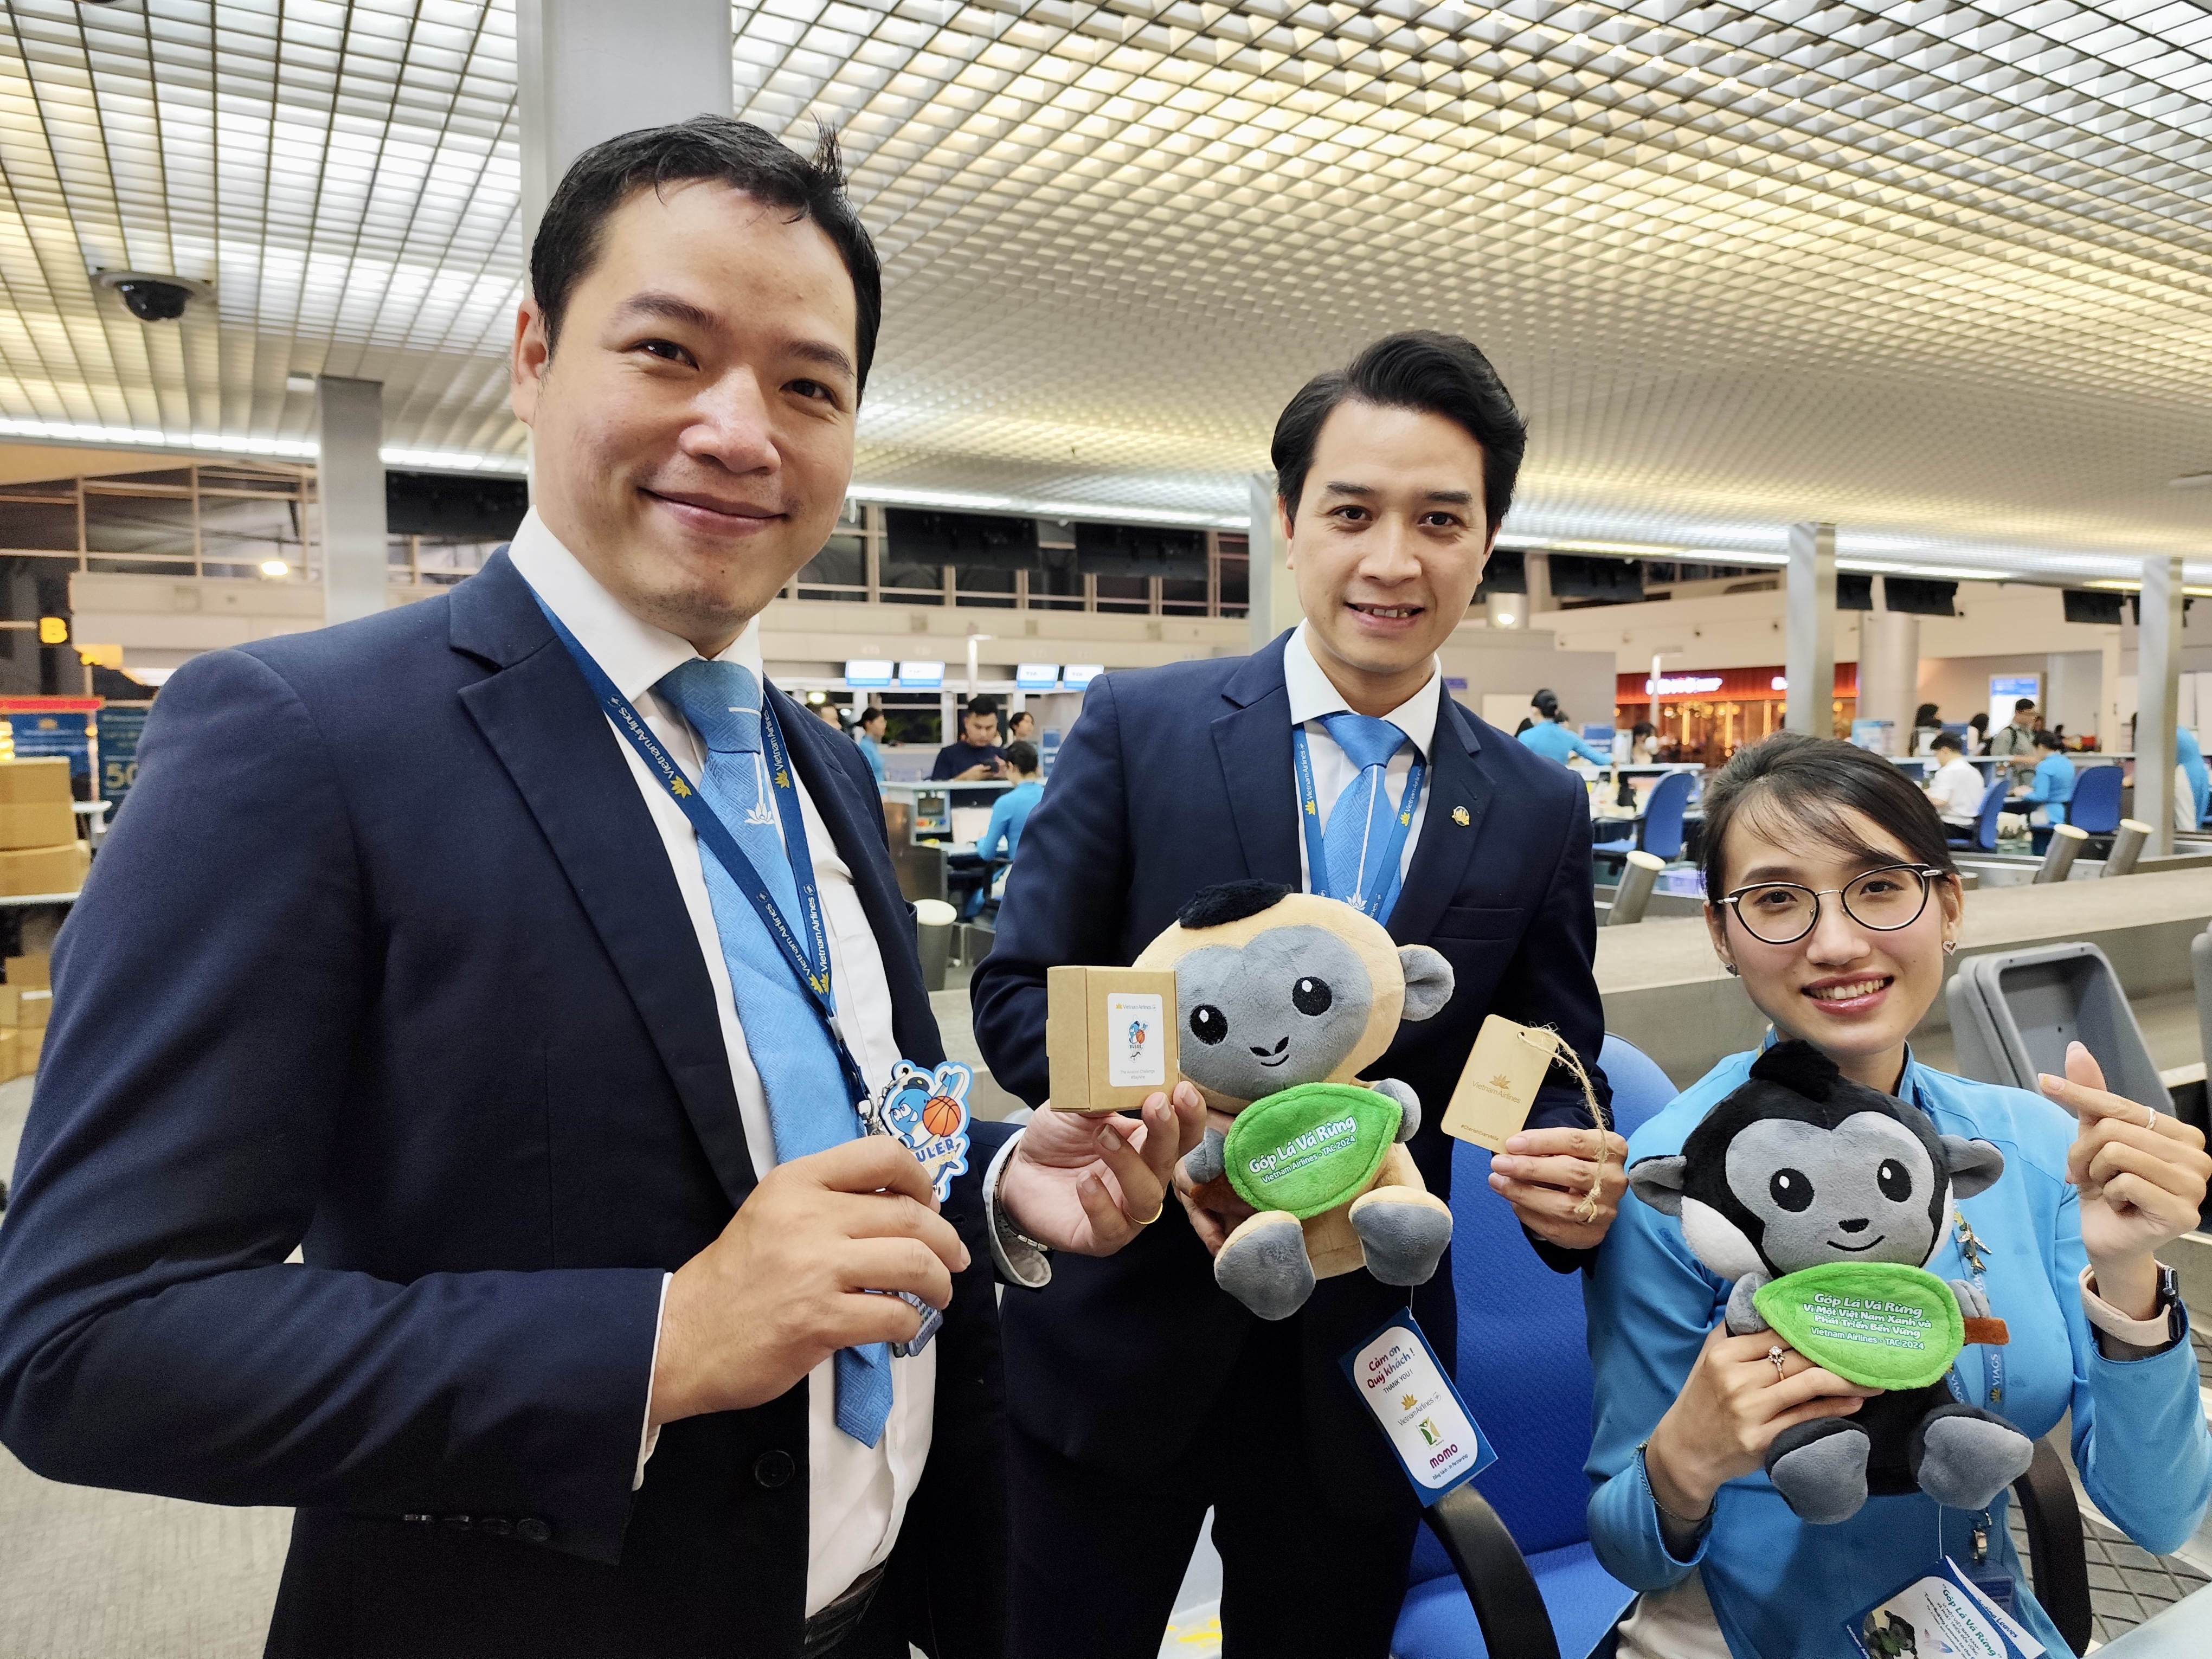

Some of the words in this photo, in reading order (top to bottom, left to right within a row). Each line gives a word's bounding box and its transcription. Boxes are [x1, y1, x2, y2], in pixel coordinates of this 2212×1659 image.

[915, 1138, 955, 1162] ULER
[1249, 1154, 1277, 1173] Góp
[1276, 1141, 1297, 1160] Lá
[1295, 1131, 1317, 1150] Vá
[1315, 1116, 1356, 1142] Rừng
[1261, 1166, 1292, 1183] Vietnam
[1292, 1153, 1318, 1170] Airlines
[1321, 1144, 1336, 1155] TAC
[1335, 1135, 1355, 1149] 2024
[1803, 1303, 1814, 1312] Vì
[1816, 1306, 1837, 1317] Một
[1838, 1309, 1859, 1320] Việt
[1860, 1311, 1885, 1322] Nam
[1887, 1315, 1916, 1327] Xanh
[1917, 1320, 1932, 1328] và
[1814, 1293, 1842, 1308] Góp
[1843, 1297, 1861, 1308] Lá
[1864, 1300, 1882, 1310] Vá
[1884, 1302, 1923, 1319] Rừng
[1811, 1326, 1846, 1339] Vietnam
[1847, 1333, 1877, 1343] Airlines
[1885, 1338, 1900, 1347] TAC
[1901, 1340, 1925, 1350] 2024
[1814, 1315, 1840, 1325] Phát
[1841, 1318, 1869, 1330] Triển
[1869, 1323, 1891, 1333] Bền
[1892, 1326, 1921, 1339] Vững
[1367, 1371, 1386, 1388] Quý
[1383, 1352, 1411, 1377] khách
[1368, 1354, 1389, 1372] Cảm
[1990, 1353, 2000, 1386] VIAGS
[1383, 1378, 1400, 1394] THANK
[1955, 1607, 1967, 1619] Lá
[1965, 1618, 1978, 1632] Vá
[1996, 1617, 2018, 1638] Leaves
